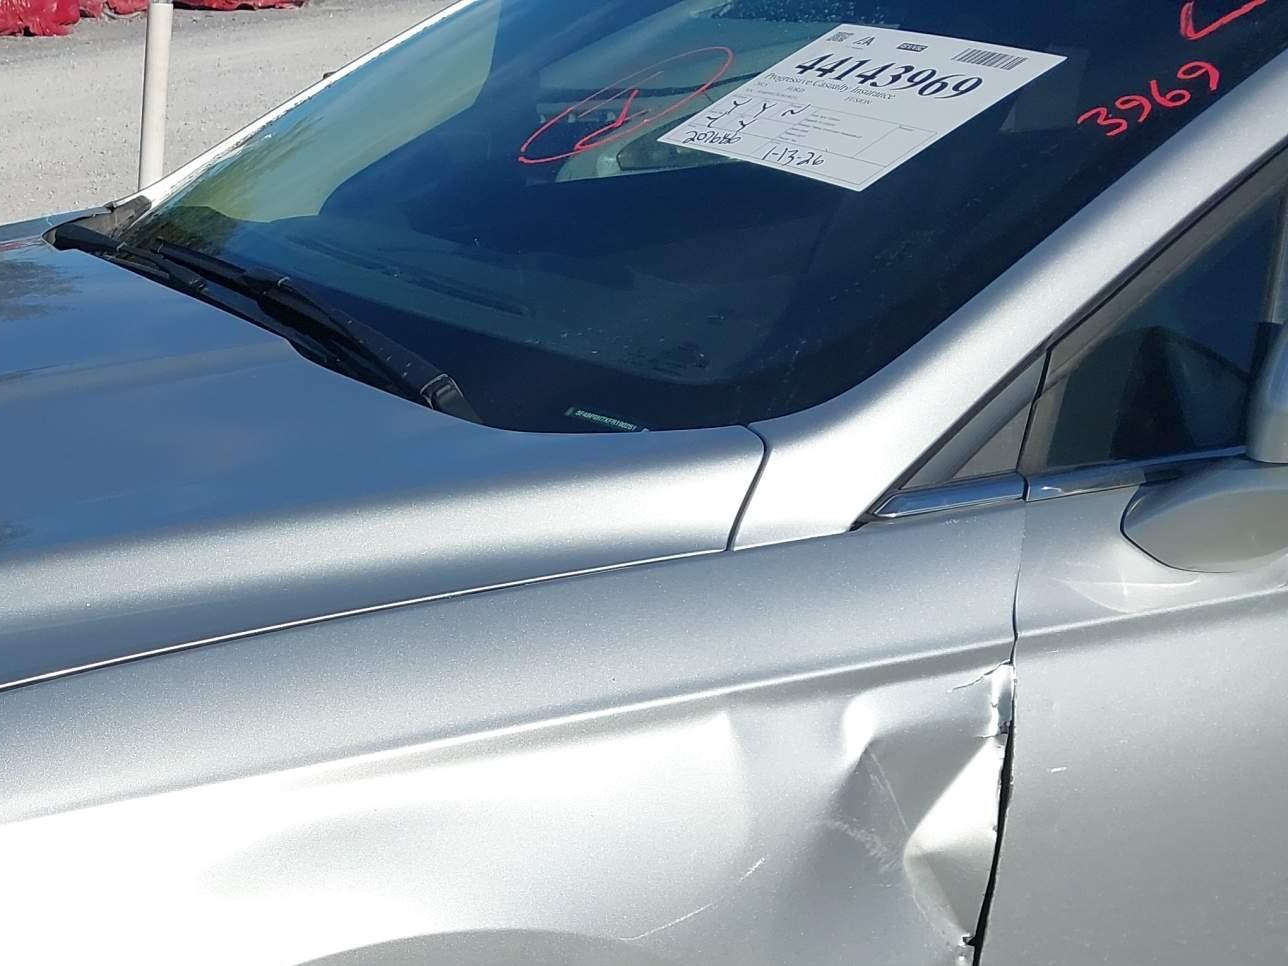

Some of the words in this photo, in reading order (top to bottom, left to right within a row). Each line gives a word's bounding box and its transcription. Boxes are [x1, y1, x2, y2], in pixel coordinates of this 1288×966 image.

[765, 72, 813, 86] Progressive
[813, 79, 850, 92] Casualty
[851, 84, 896, 100] Insurance
[795, 53, 983, 99] 44143969
[1077, 61, 1220, 136] 3969
[761, 145, 825, 167] 1-13-26
